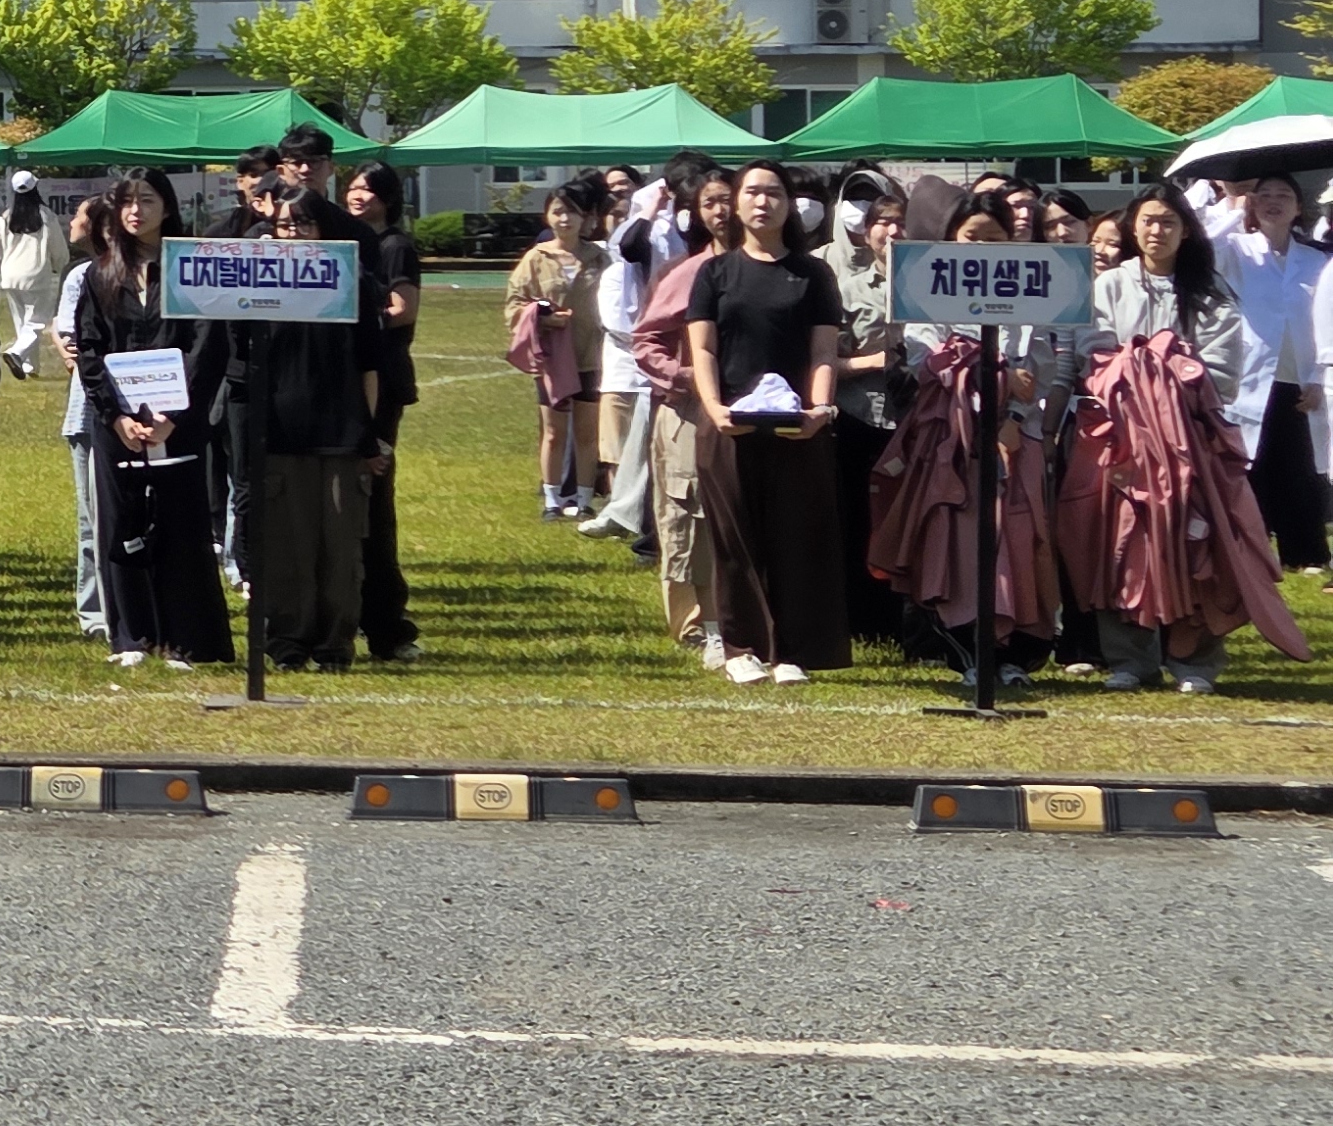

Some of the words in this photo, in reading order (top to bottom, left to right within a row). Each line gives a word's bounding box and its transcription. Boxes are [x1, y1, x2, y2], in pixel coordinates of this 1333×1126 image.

[179, 256, 340, 289] 디지털비즈니스과
[930, 258, 1052, 298] 치위생과
[52, 781, 80, 794] STOP
[477, 790, 507, 803] STOP
[1050, 798, 1081, 813] STOP
